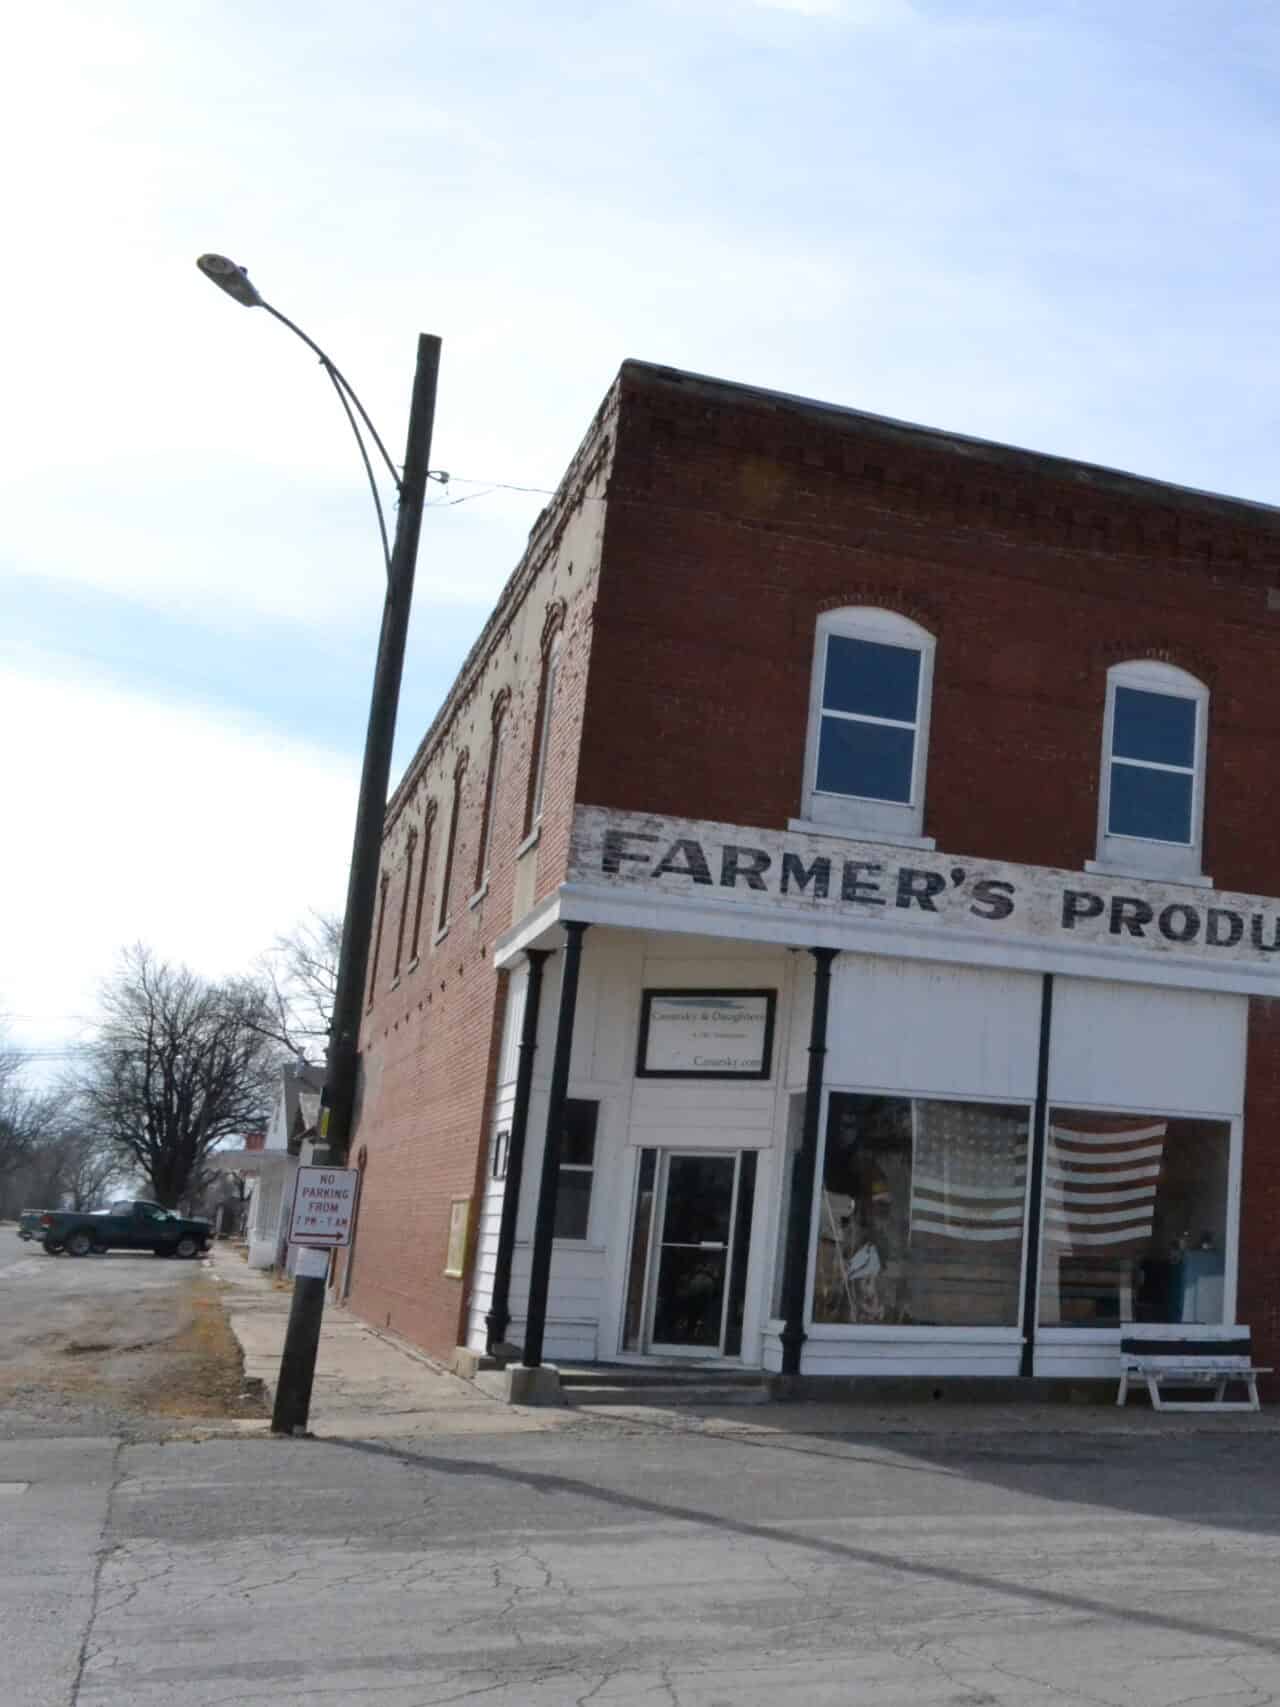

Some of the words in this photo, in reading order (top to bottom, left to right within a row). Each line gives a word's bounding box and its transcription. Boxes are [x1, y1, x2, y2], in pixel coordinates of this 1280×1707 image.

[600, 828, 1017, 921] FARMER'S
[320, 1174, 335, 1185] NO
[302, 1187, 349, 1200] PARKING
[308, 1202, 339, 1213] FROM
